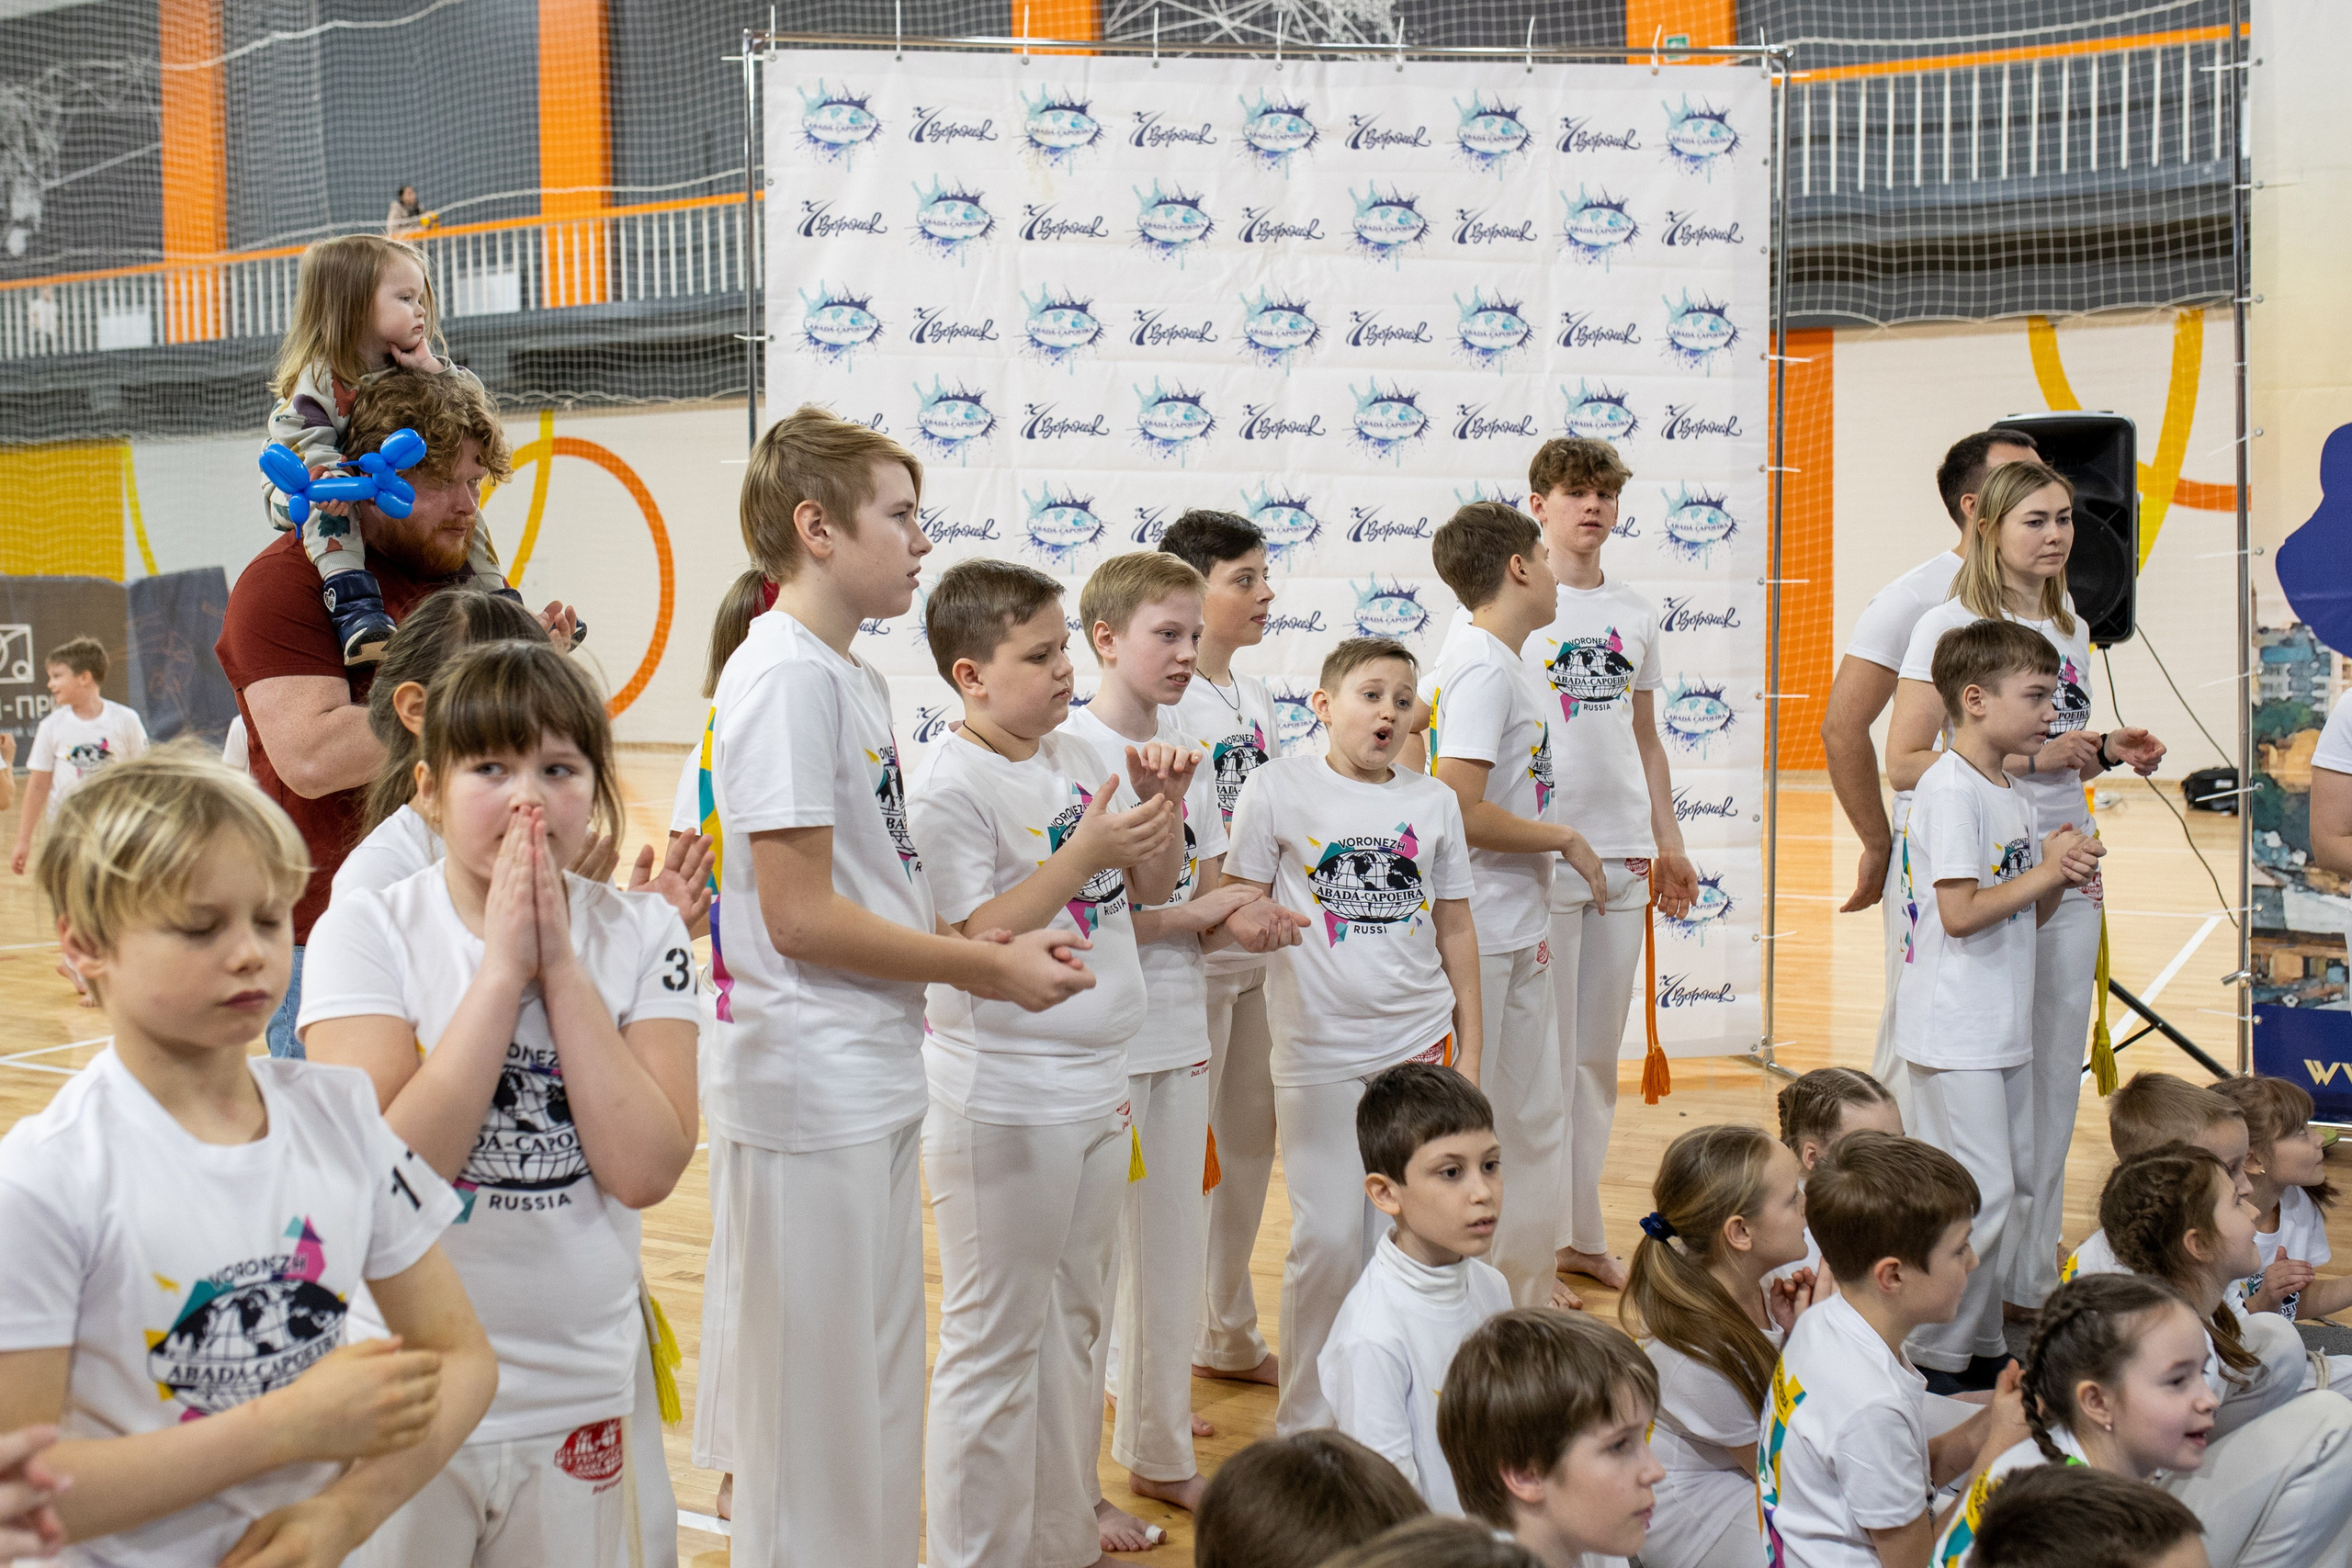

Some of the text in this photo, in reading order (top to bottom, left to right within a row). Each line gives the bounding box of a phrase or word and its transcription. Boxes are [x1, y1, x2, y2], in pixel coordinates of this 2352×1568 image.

[1567, 637, 1615, 649] VORONEZH
[1582, 703, 1611, 712] RUSSIA
[1221, 734, 1260, 748] VORONEZH
[1338, 836, 1407, 852] VORONEZH
[1169, 892, 1182, 903] SIA
[1353, 924, 1389, 934] RUSSI
[662, 948, 697, 995] 3
[489, 1193, 572, 1212] RUSSIA
